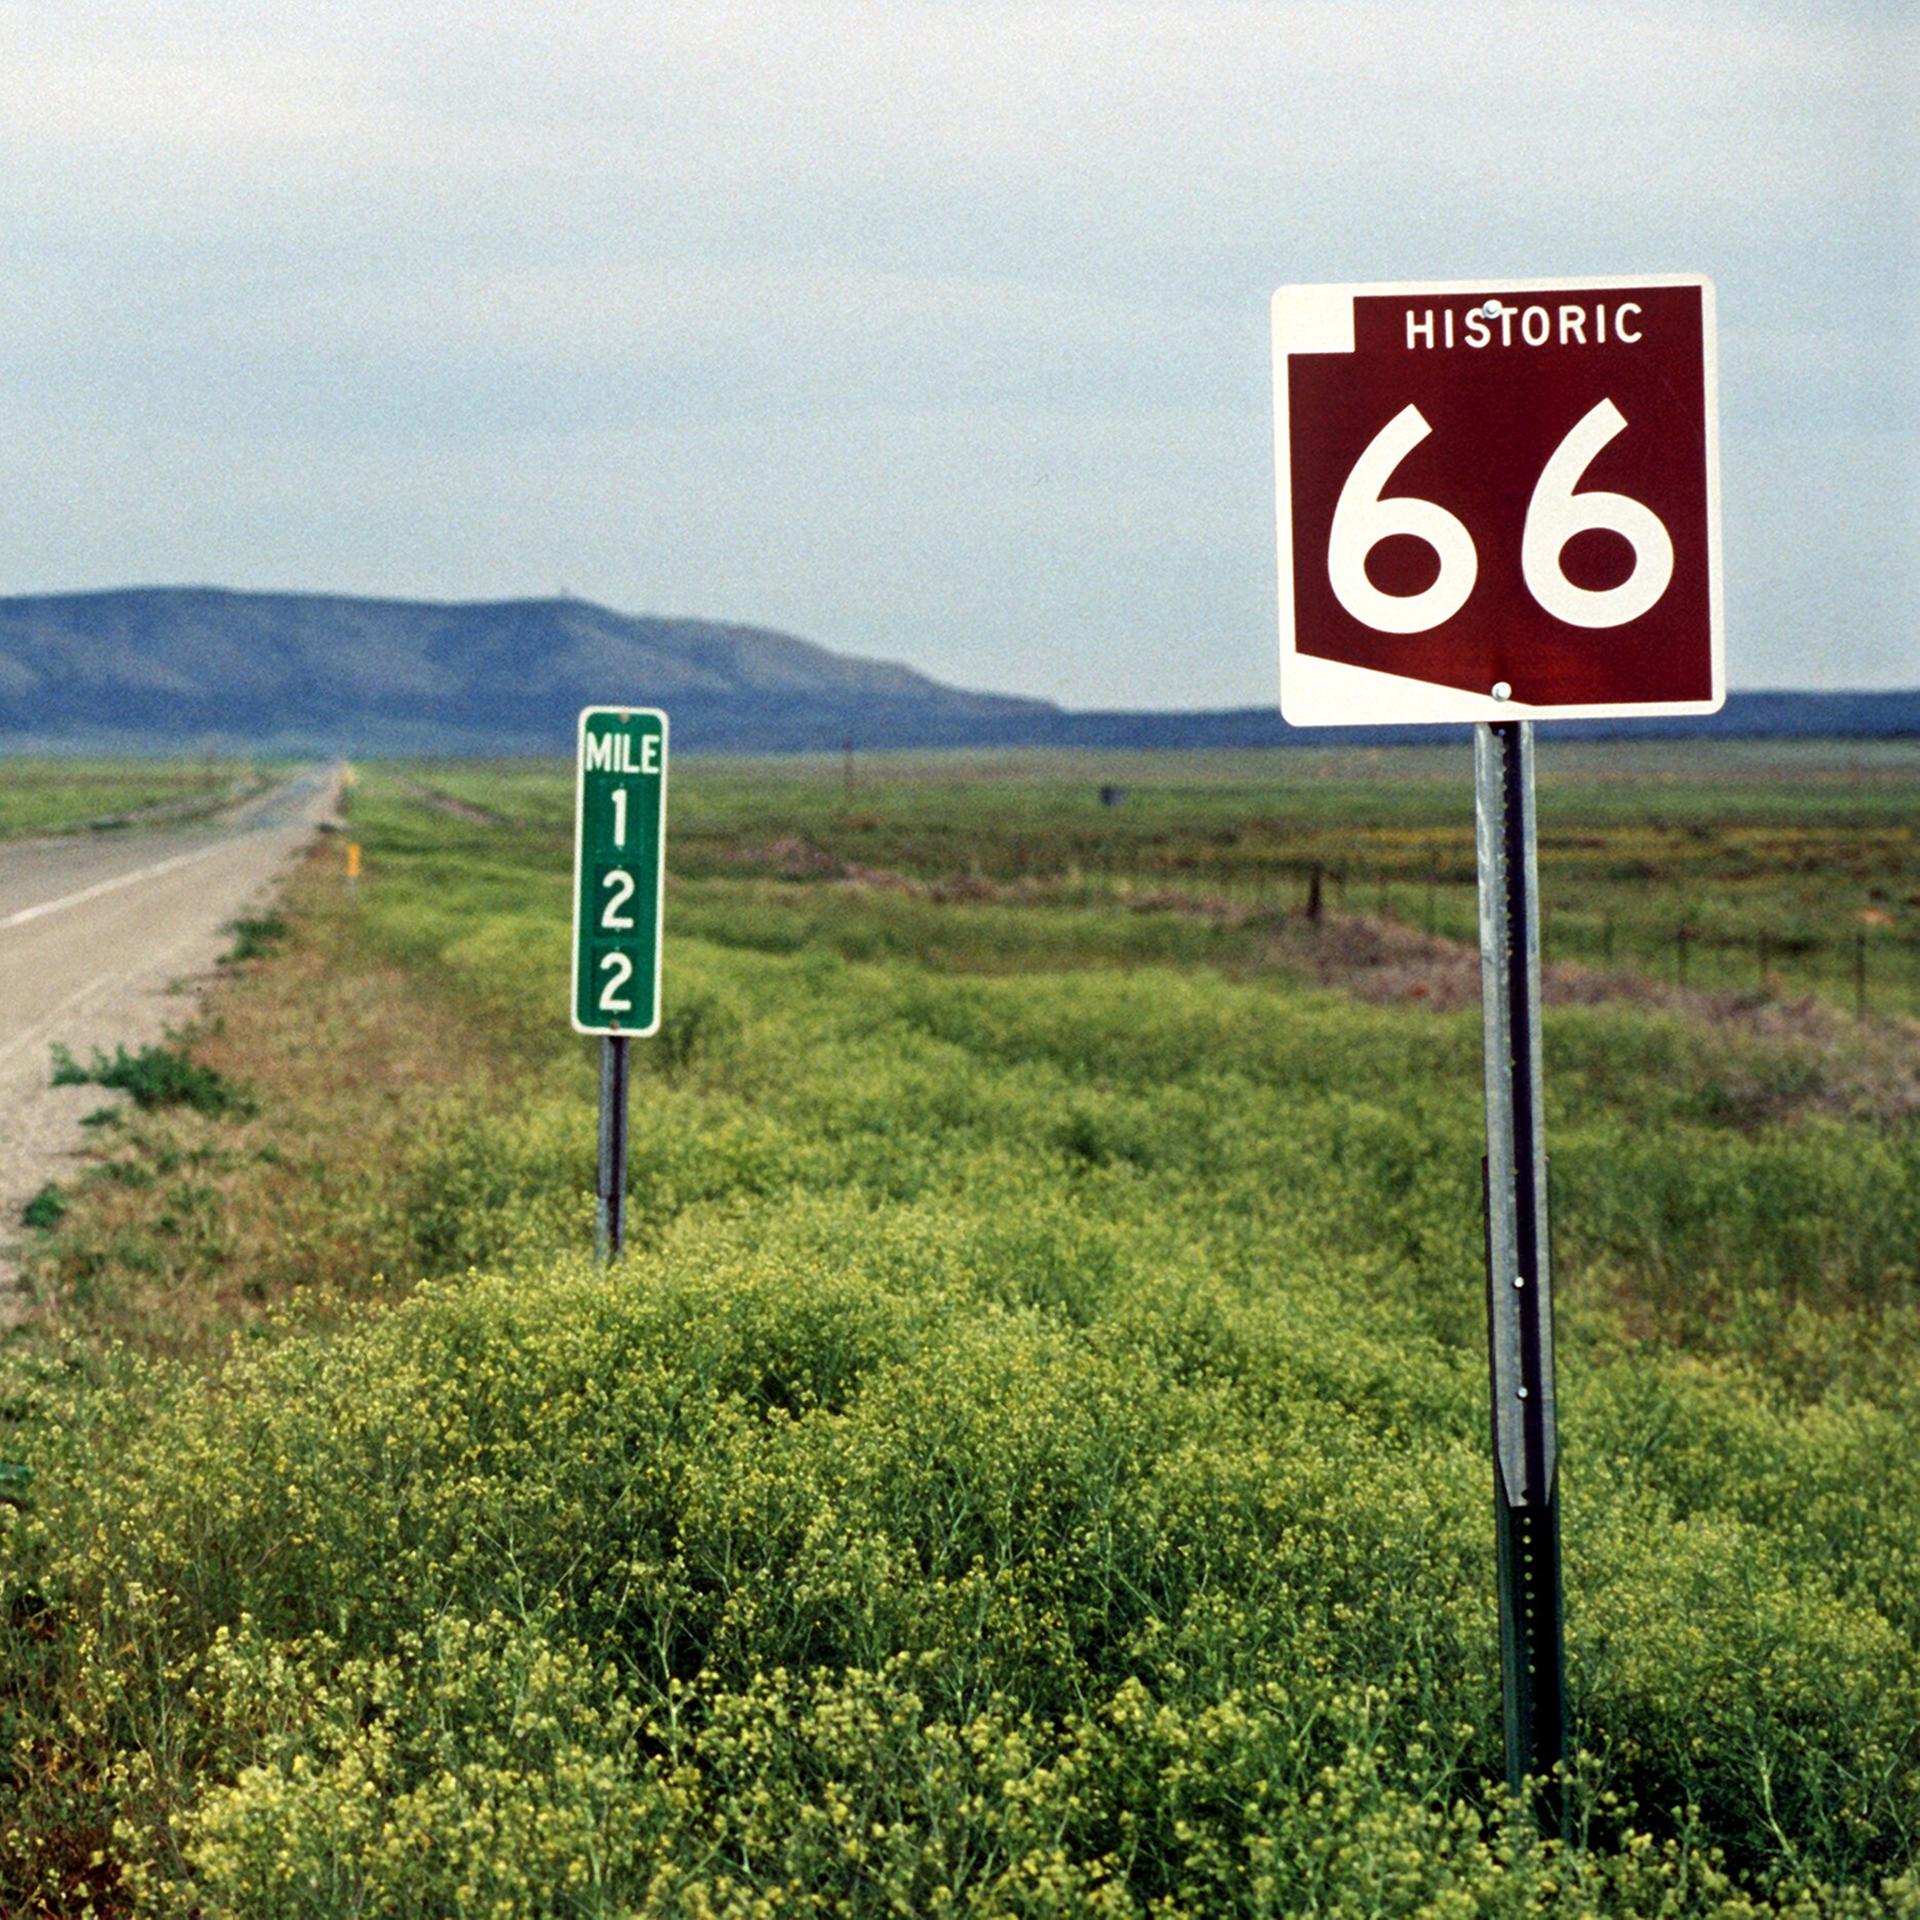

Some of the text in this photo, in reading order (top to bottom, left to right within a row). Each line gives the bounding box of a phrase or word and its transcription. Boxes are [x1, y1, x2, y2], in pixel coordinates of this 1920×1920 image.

[1405, 302, 1643, 350] HISTORIC
[1327, 397, 1675, 635] 66
[586, 731, 661, 774] MILE
